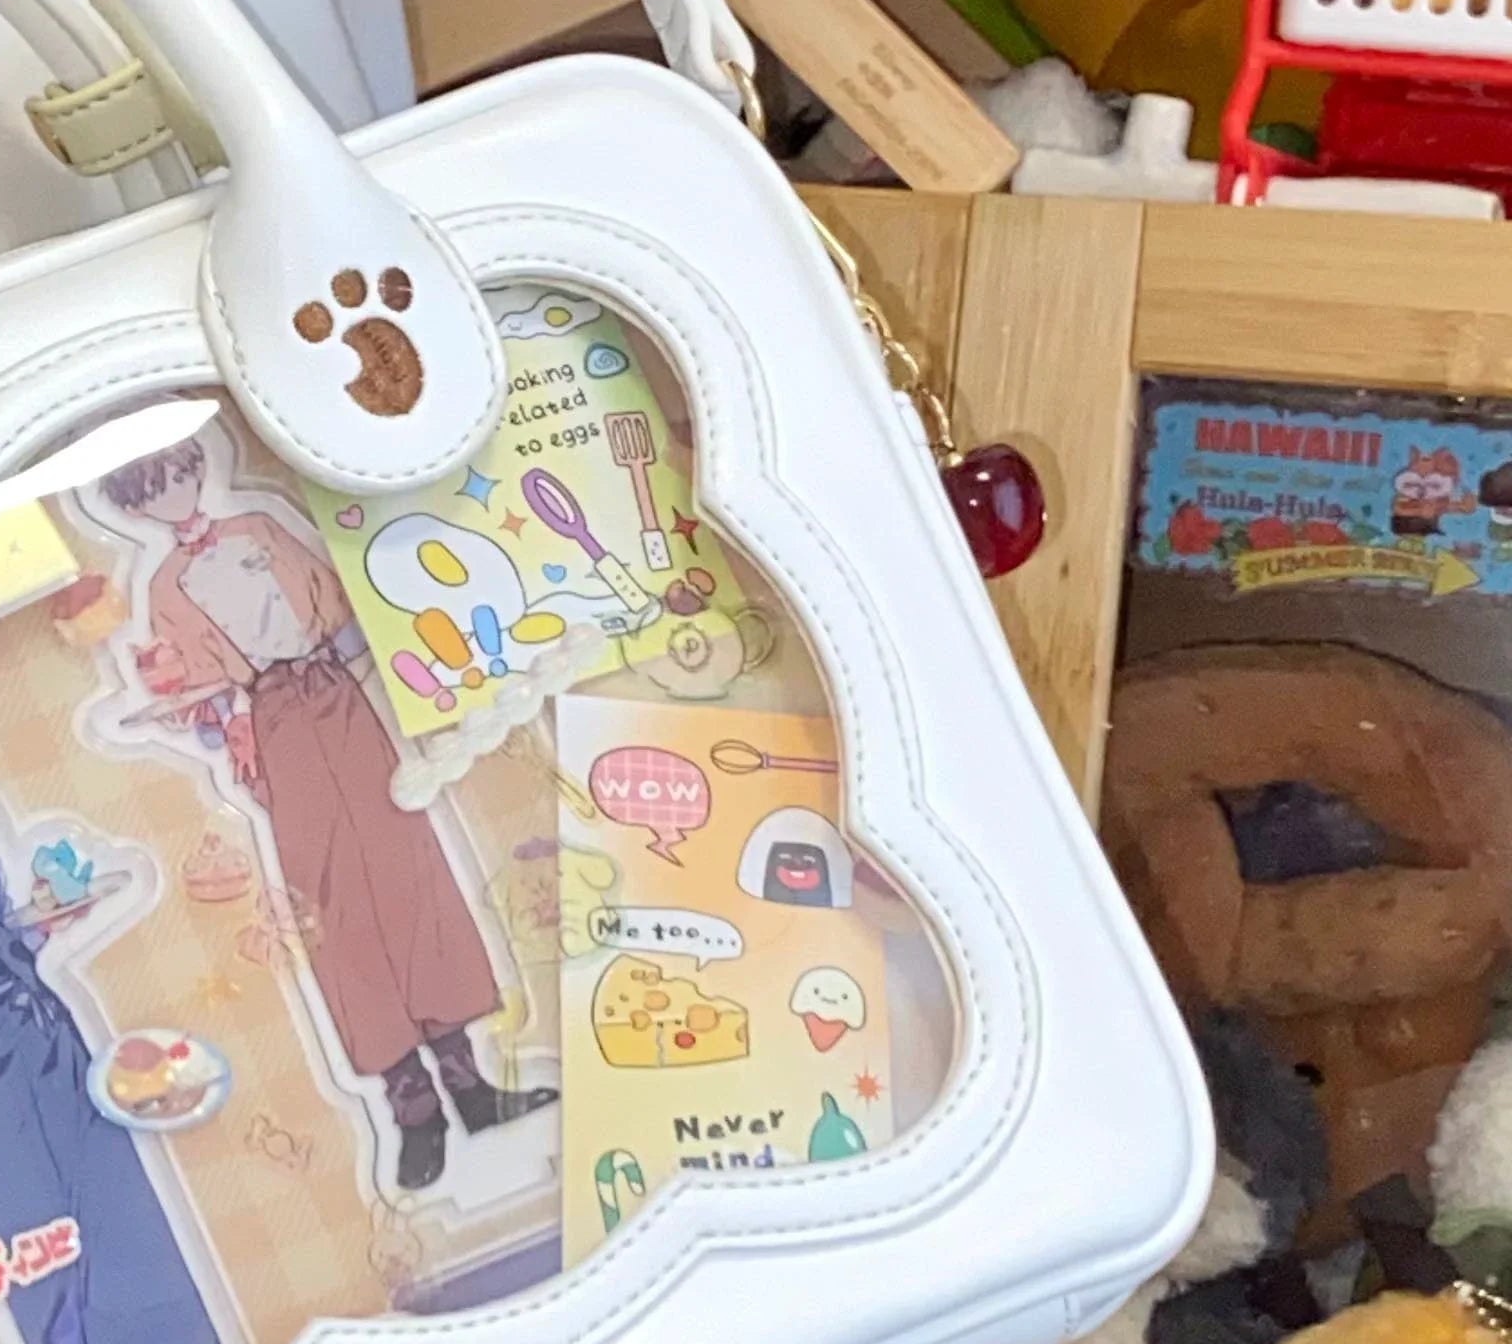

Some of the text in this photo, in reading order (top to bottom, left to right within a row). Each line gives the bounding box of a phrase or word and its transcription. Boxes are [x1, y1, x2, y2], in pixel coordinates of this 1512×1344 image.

[515, 422, 600, 457] to eggs
[597, 778, 700, 802] WOW
[598, 917, 640, 939] Me
[673, 1110, 784, 1143] Never
[679, 1143, 774, 1170] mind
